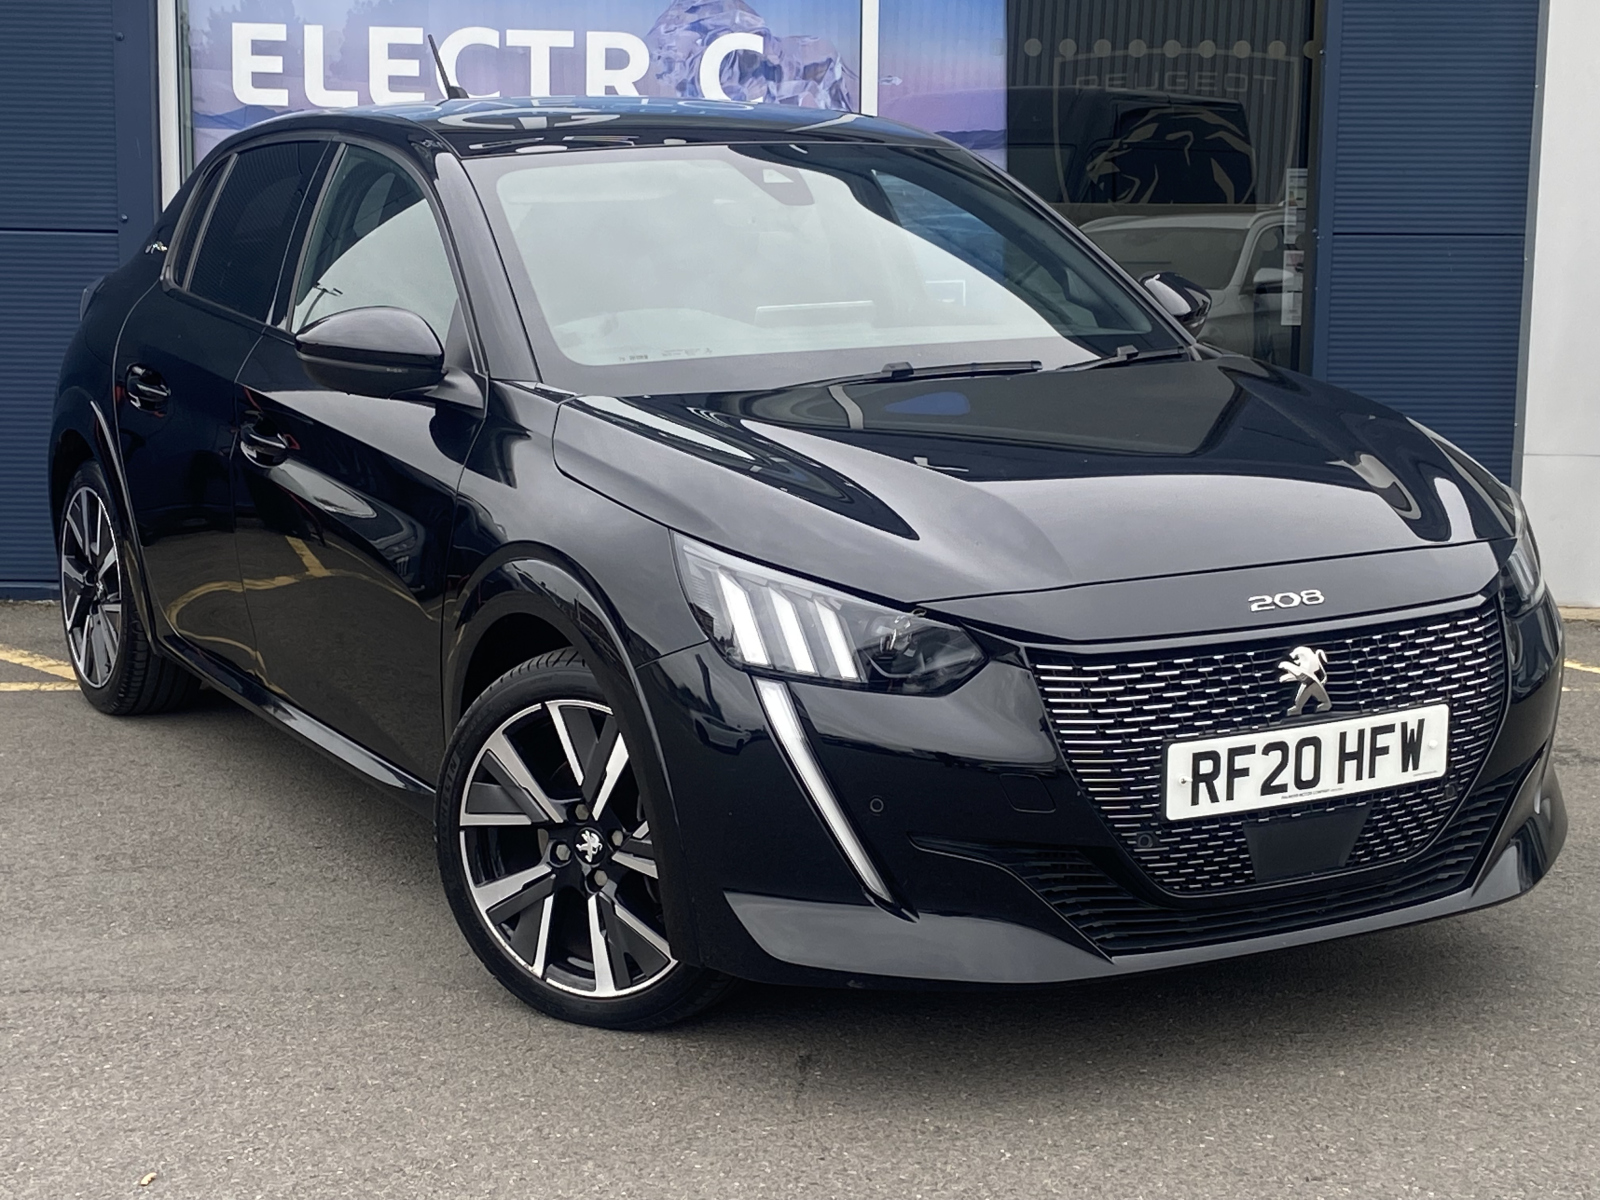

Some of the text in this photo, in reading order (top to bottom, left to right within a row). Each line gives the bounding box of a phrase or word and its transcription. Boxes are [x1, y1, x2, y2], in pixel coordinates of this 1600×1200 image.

[1076, 71, 1276, 95] PEUGEOT
[1248, 589, 1325, 612] 208
[1190, 718, 1425, 806] RF20 HFW
